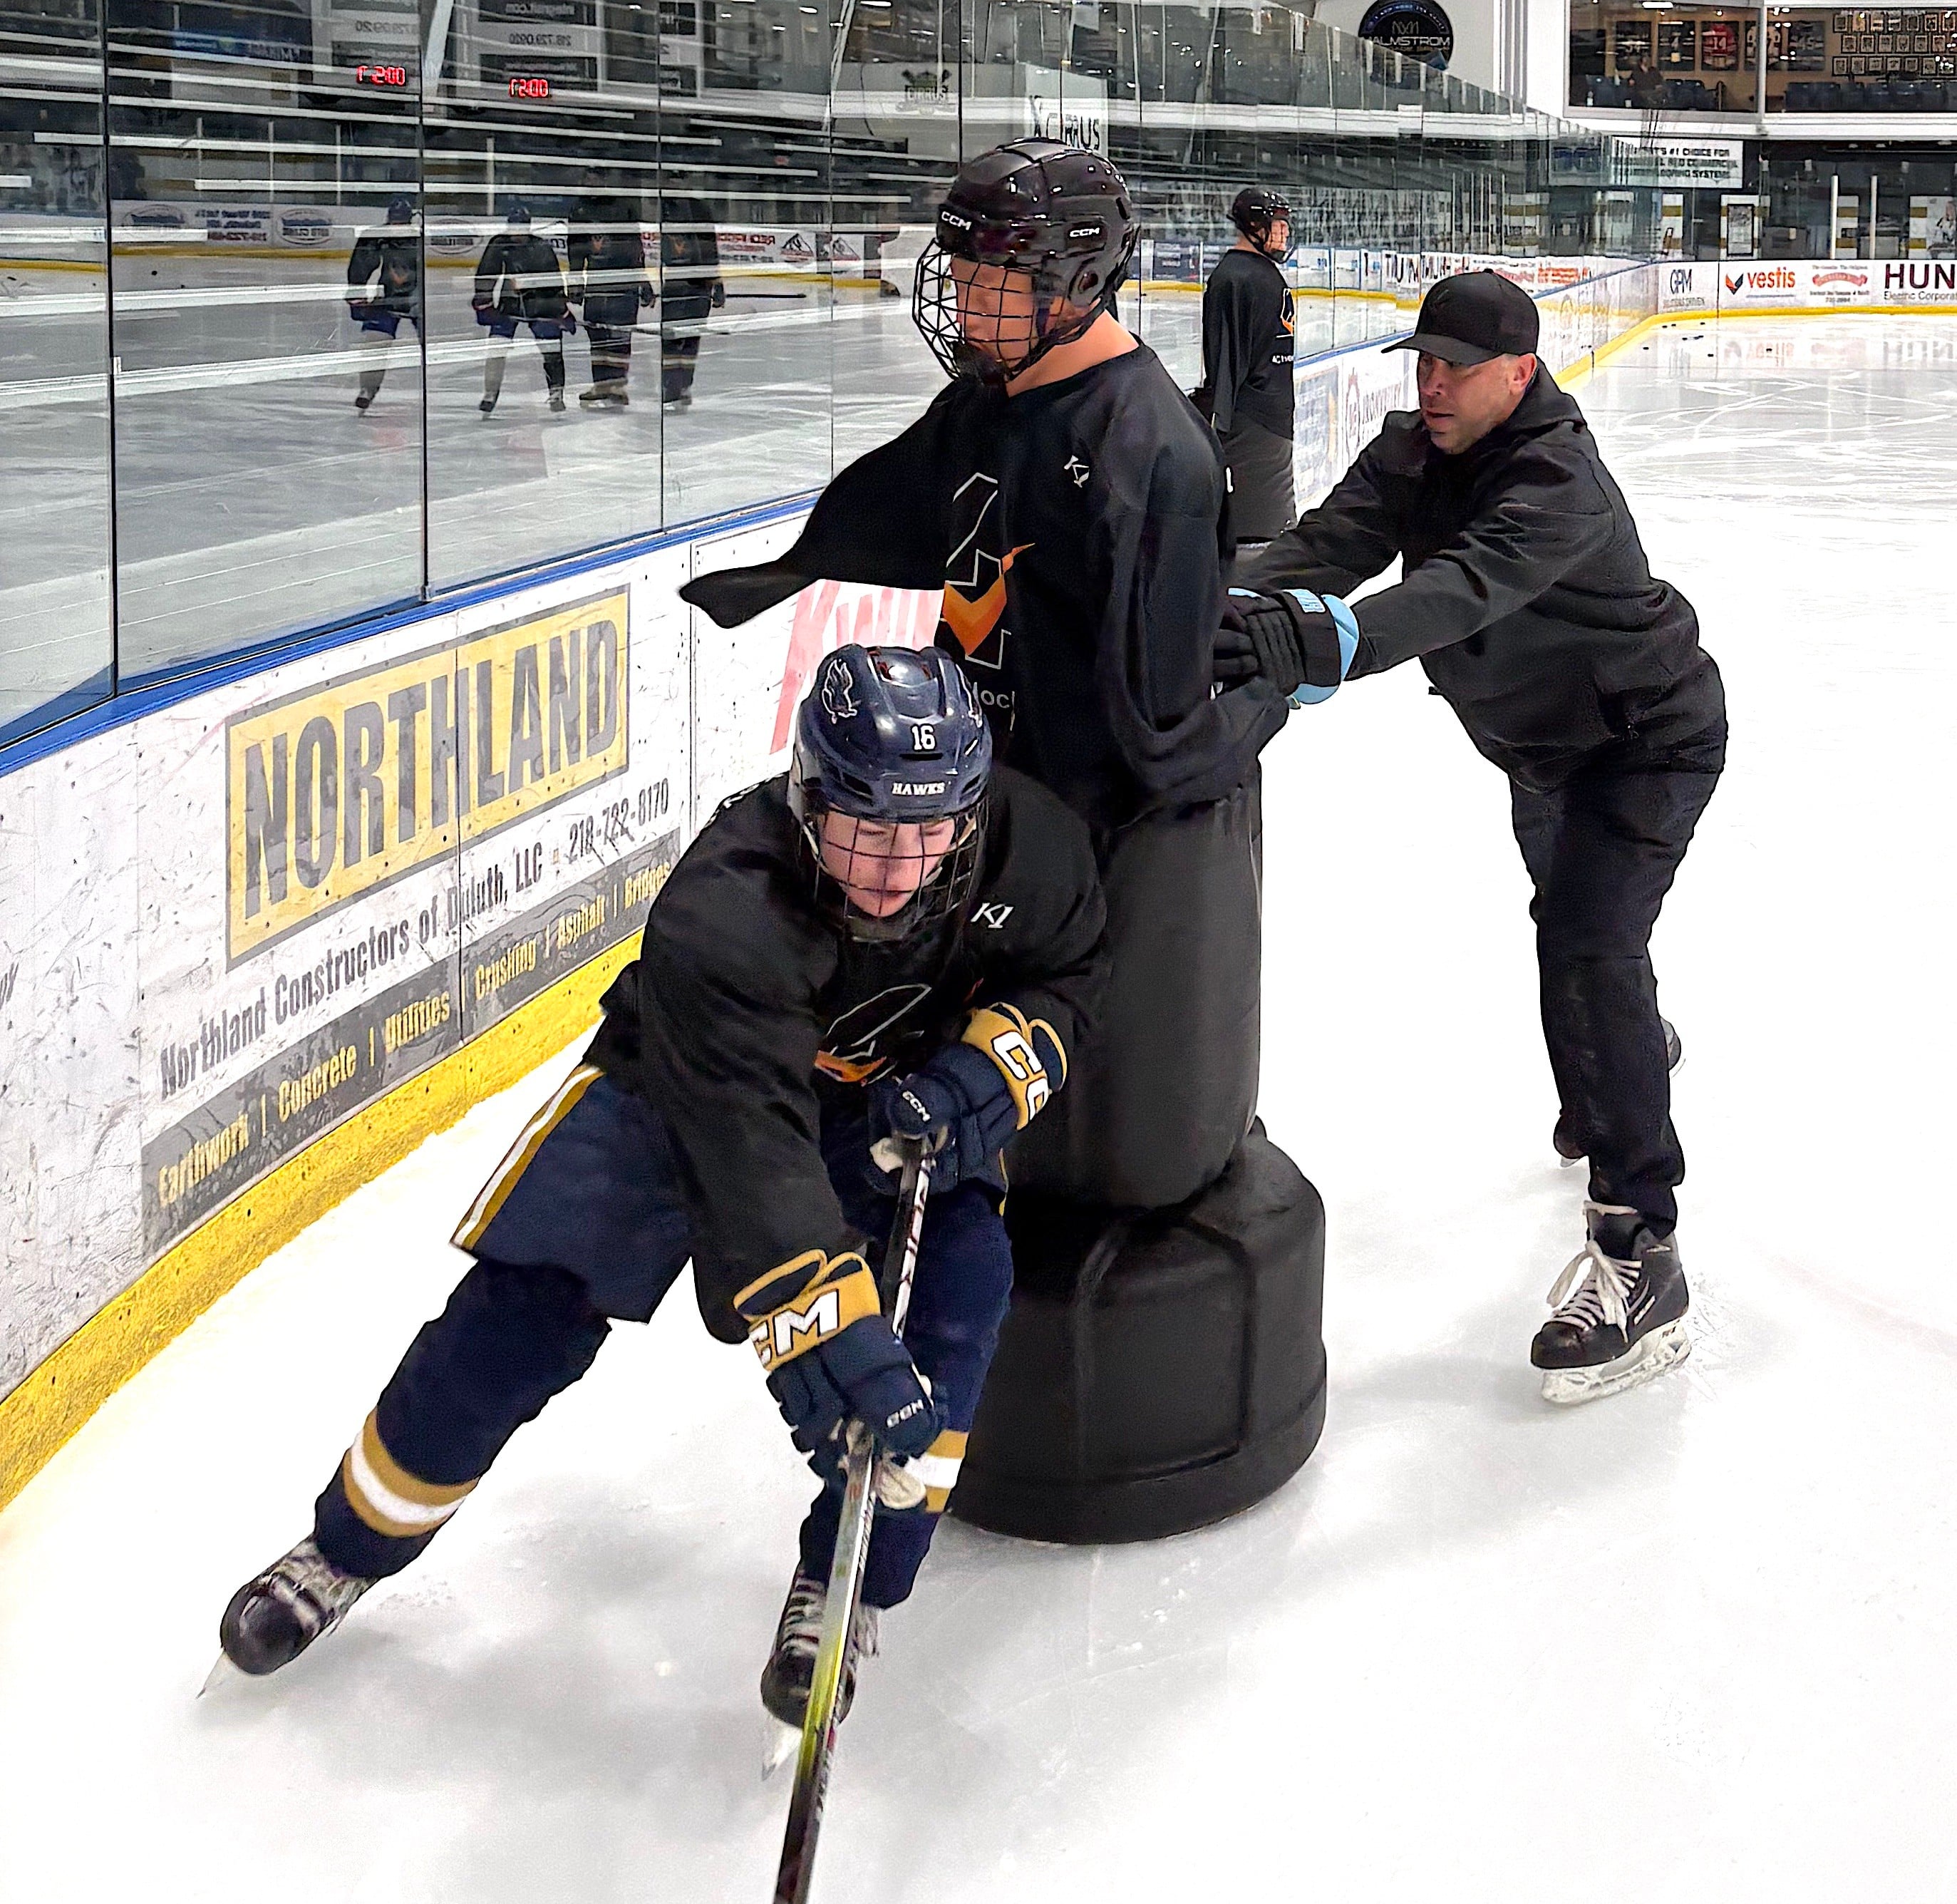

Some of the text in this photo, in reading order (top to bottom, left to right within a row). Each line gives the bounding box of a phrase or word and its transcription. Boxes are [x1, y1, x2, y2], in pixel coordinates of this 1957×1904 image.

[941, 211, 971, 230] CCM
[1069, 227, 1100, 237] CCM
[1747, 267, 1796, 289] vestis
[912, 725, 936, 751] 16
[245, 619, 617, 920] NORTHLAND
[892, 781, 945, 796] HAWKS
[160, 987, 266, 1102] Northland
[274, 918, 410, 1025] Constructors
[418, 895, 438, 944] of
[447, 864, 508, 931] Duluth,
[515, 842, 542, 892] LLC
[159, 1110, 249, 1208] Earthwork
[278, 1044, 357, 1123] Concrete
[386, 990, 450, 1054] Utilities
[474, 938, 536, 1000] Crushing
[557, 894, 606, 950] Asphalt
